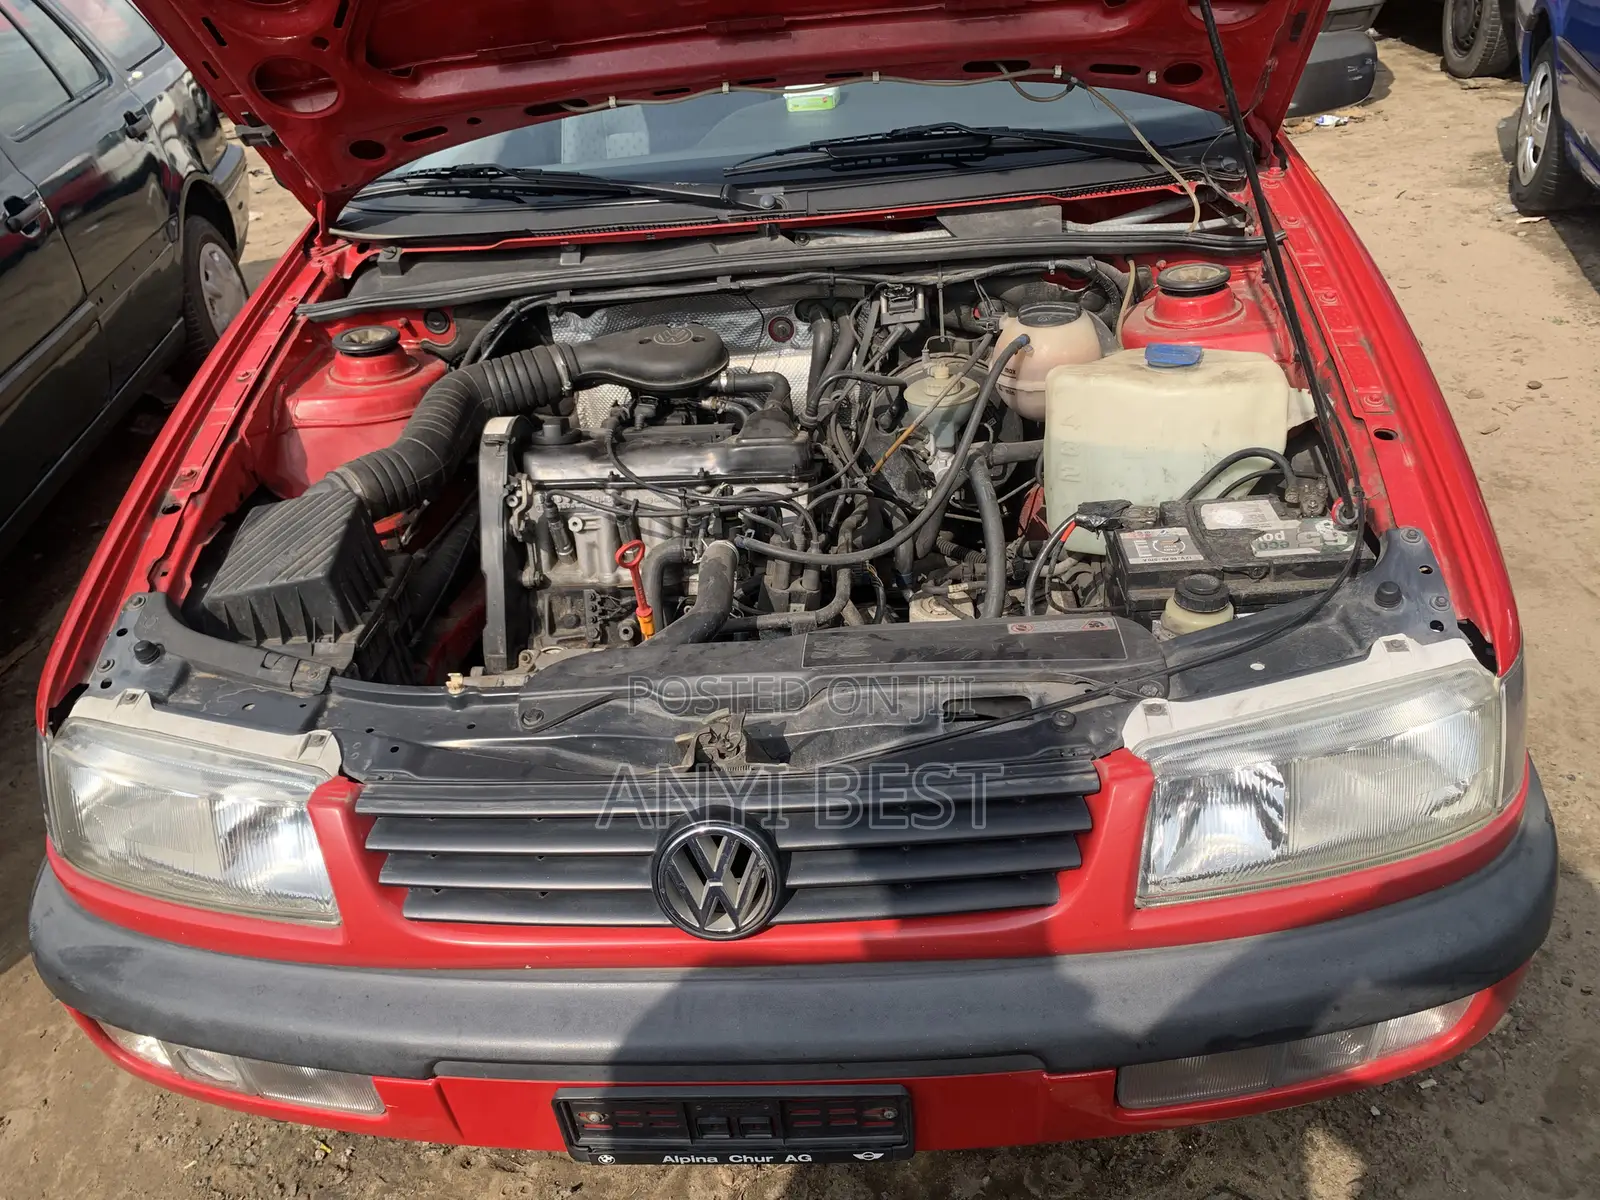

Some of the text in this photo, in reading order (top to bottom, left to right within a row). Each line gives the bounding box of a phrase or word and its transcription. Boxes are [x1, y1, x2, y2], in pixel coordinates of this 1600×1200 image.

[1258, 540, 1290, 552] eco
[662, 1154, 813, 1165] Alpina Chur AG
